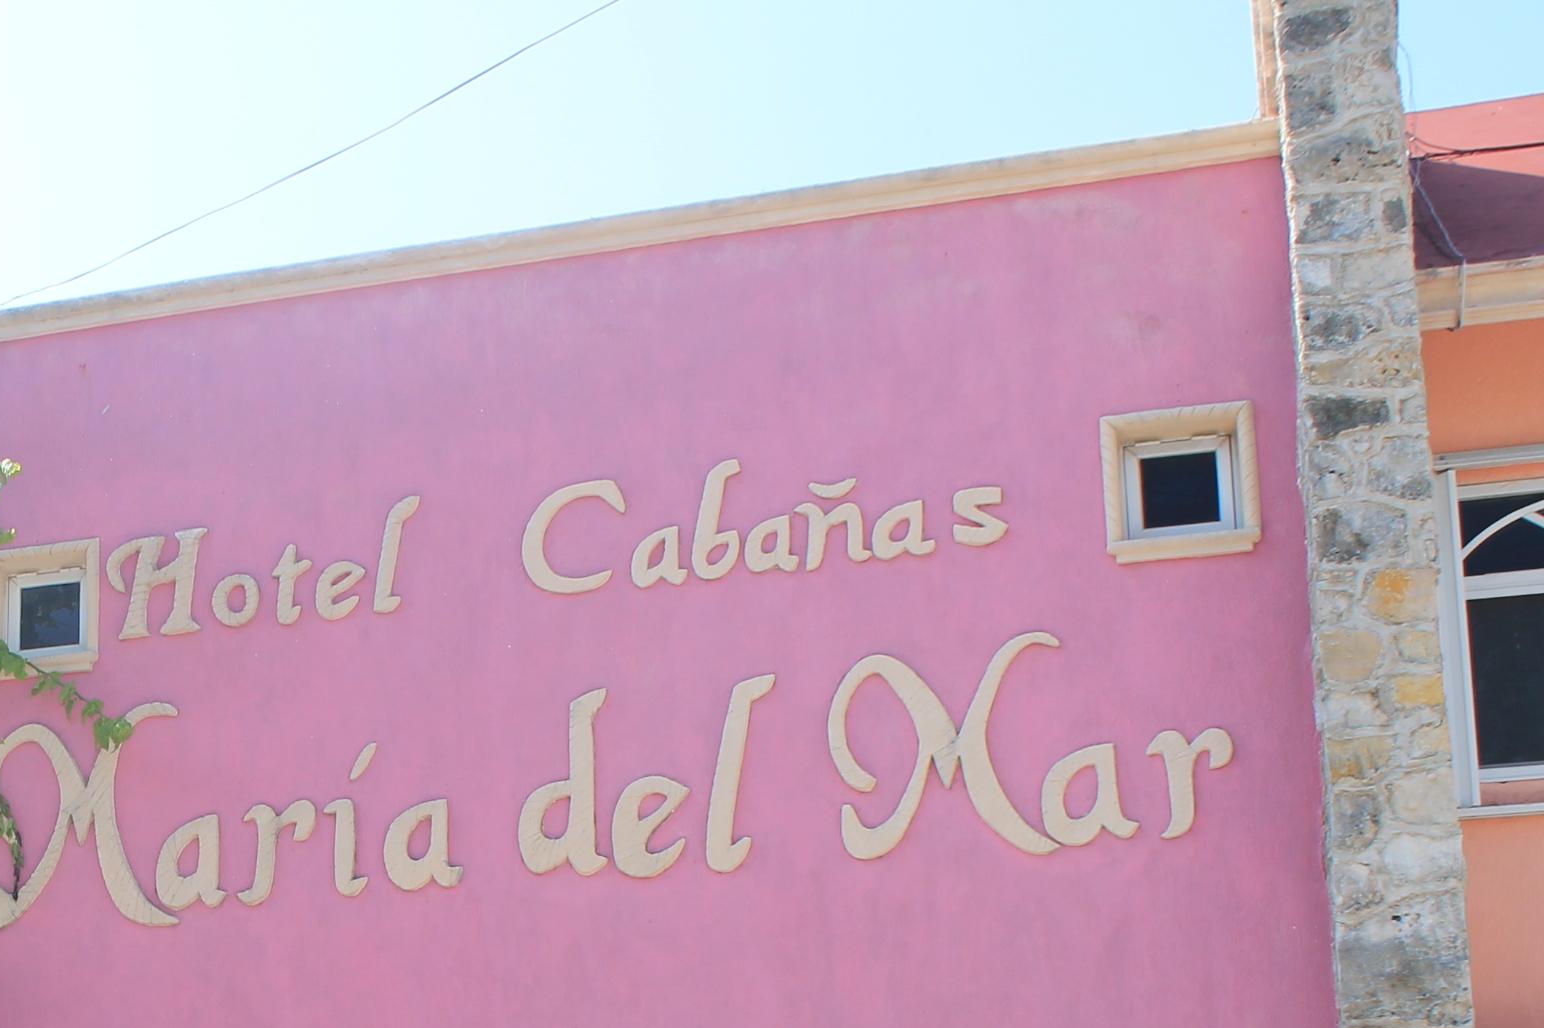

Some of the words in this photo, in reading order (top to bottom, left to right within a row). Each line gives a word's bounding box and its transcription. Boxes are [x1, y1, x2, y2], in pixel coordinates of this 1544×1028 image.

[106, 494, 423, 641] Hotel
[520, 457, 1010, 596] Cabañas
[516, 673, 778, 878] del
[826, 630, 1236, 862] Mar
